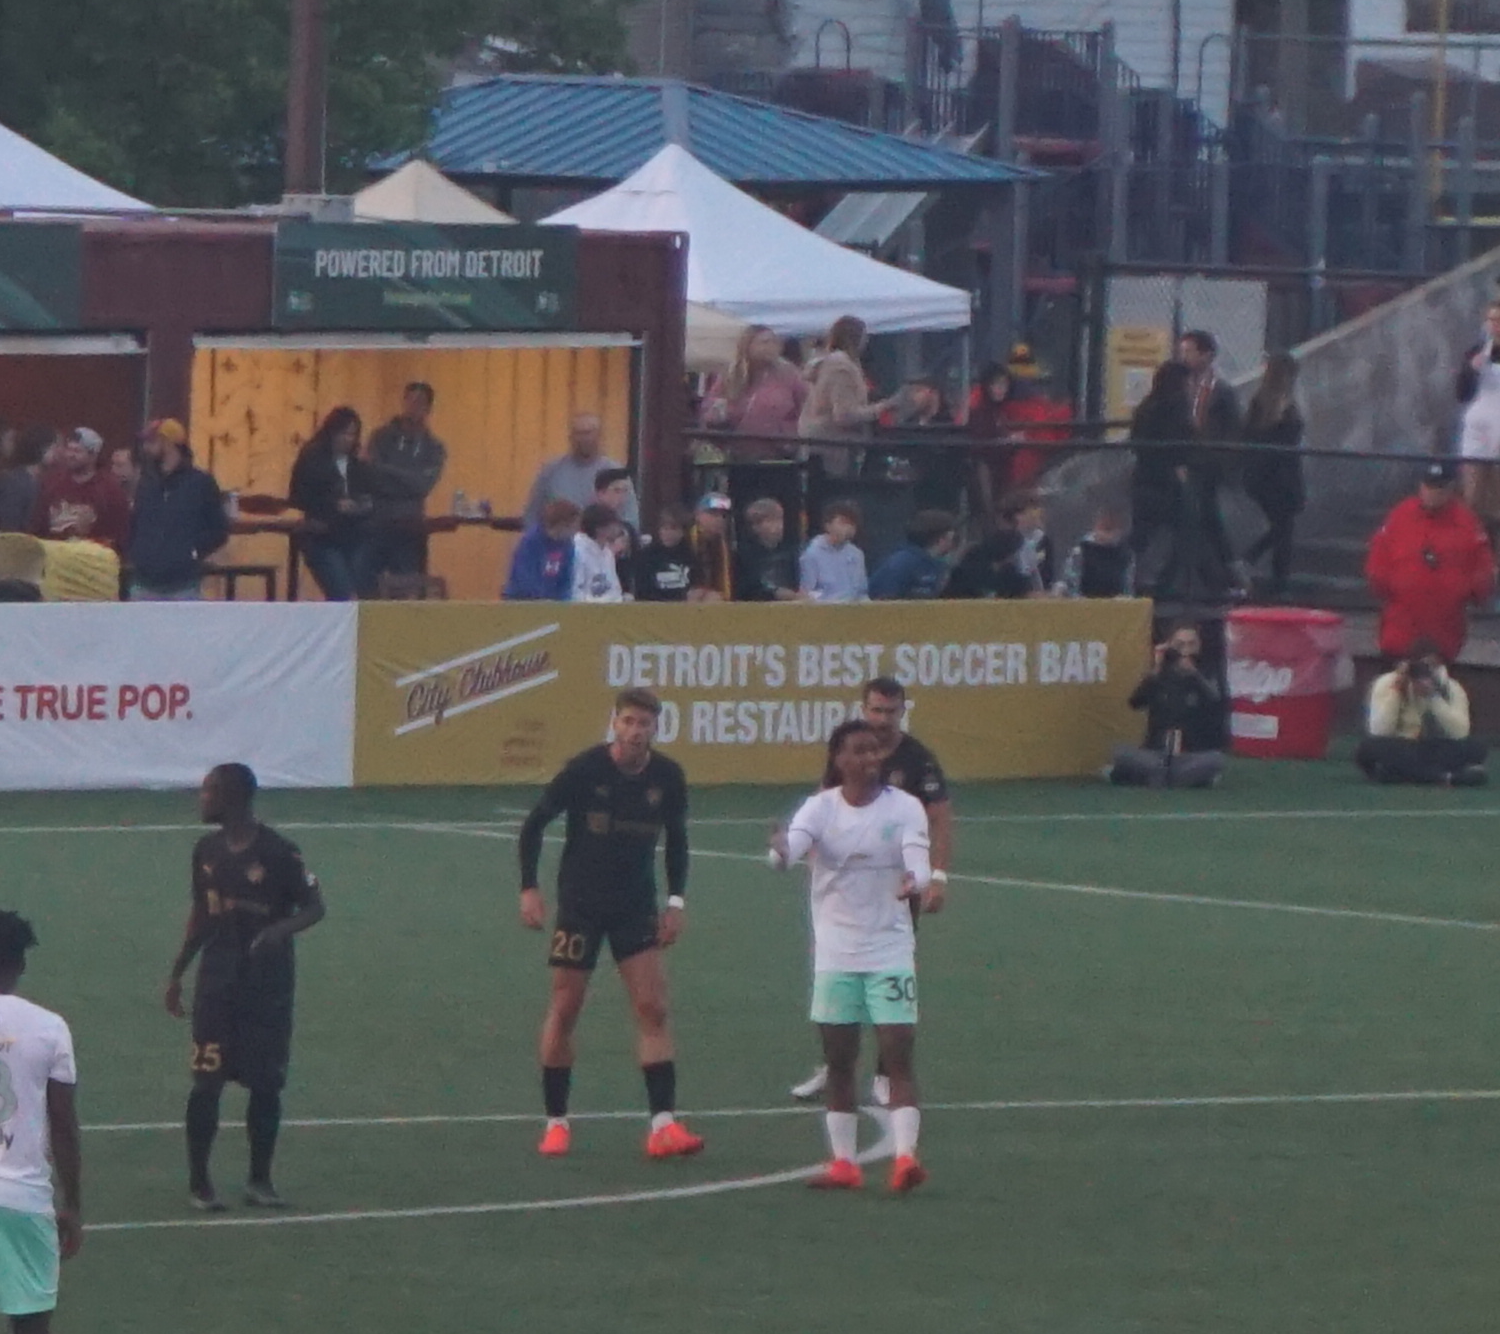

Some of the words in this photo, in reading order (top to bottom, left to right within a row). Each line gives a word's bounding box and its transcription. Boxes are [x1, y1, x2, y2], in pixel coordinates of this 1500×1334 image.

[315, 249, 405, 277] POWERED
[411, 250, 460, 278] FROM
[465, 250, 543, 278] DETROIT
[608, 643, 787, 688] DETROIT'S
[799, 644, 884, 688] BEST
[896, 642, 1028, 687] SOCCER
[1038, 641, 1108, 684] BAR
[14, 685, 108, 722] TRUE
[118, 684, 193, 721] POP.
[407, 681, 451, 725] City
[553, 930, 585, 961] 20
[886, 976, 915, 1002] 30
